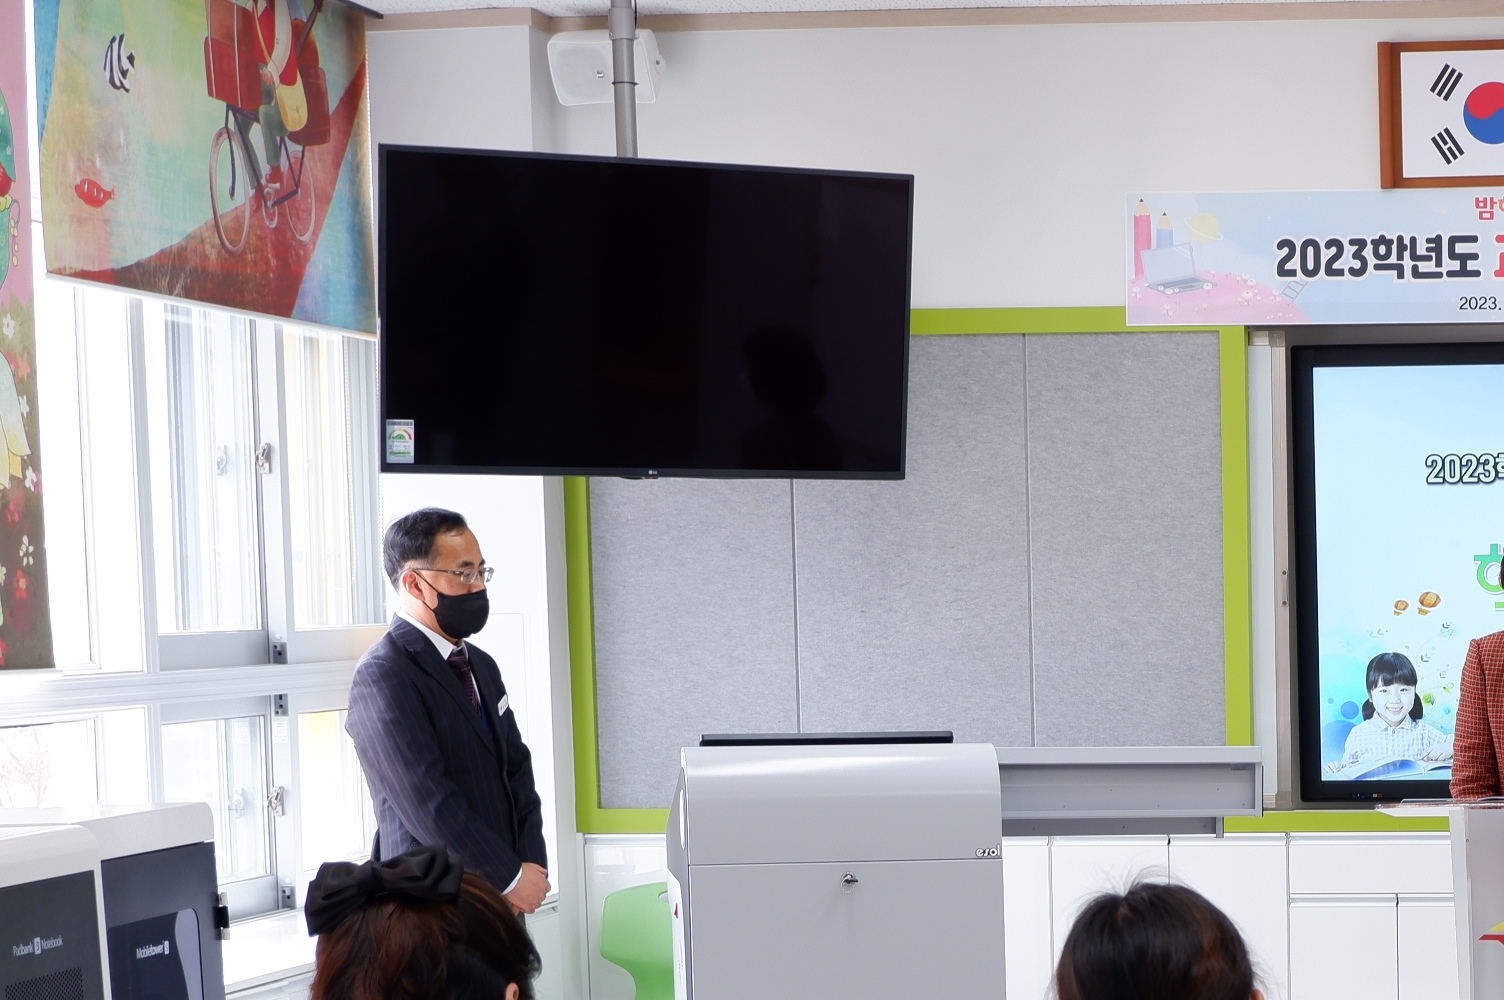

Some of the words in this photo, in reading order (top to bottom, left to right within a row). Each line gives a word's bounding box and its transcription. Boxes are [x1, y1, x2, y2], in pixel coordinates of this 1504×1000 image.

[1276, 234, 1482, 279] 2023학년도
[1459, 296, 1502, 312] 2023.
[975, 844, 1000, 857] esol
